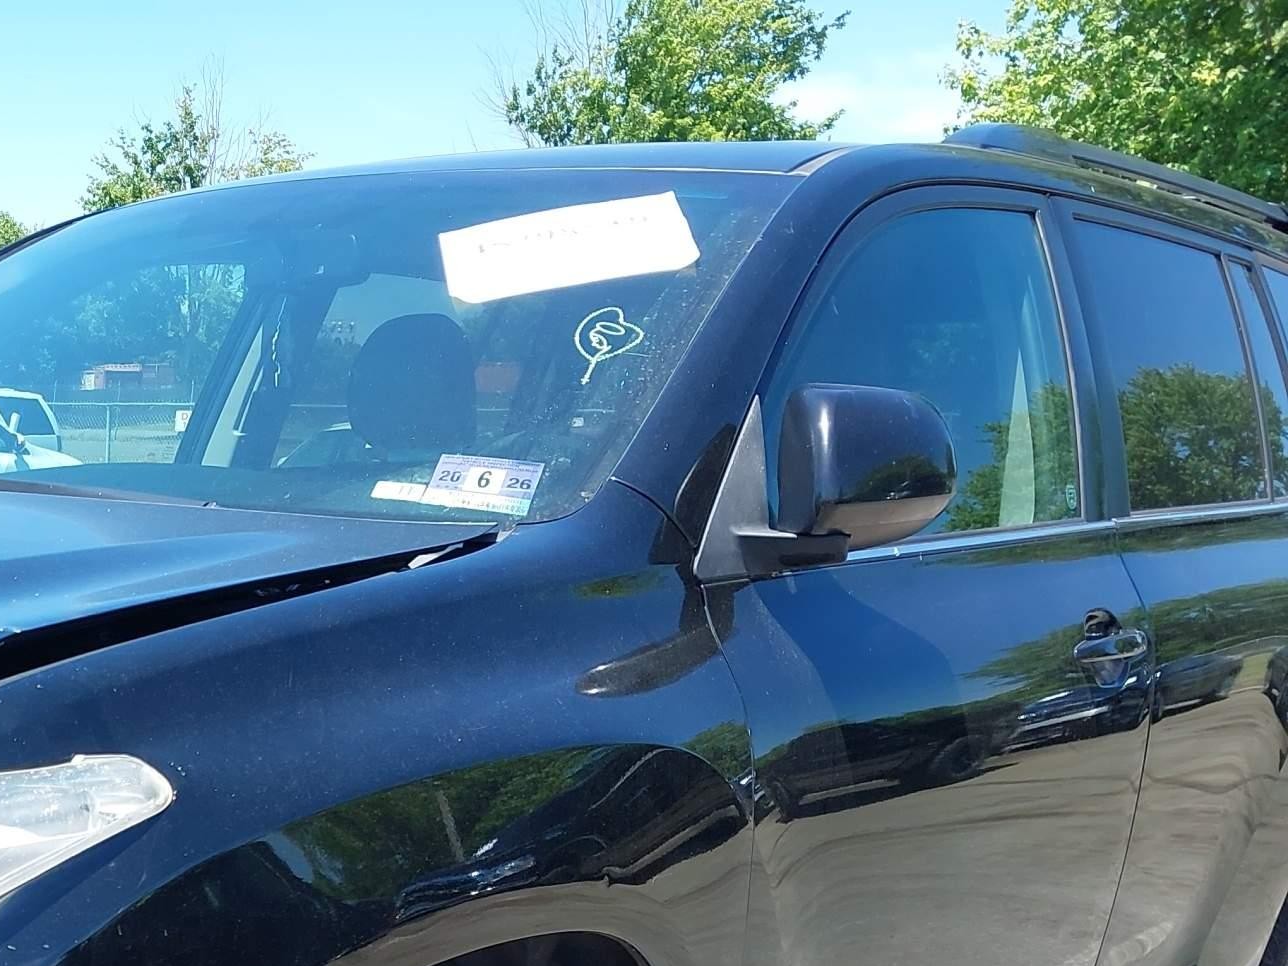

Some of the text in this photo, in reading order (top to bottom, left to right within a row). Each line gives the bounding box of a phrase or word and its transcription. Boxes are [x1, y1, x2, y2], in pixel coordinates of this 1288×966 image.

[438, 470, 533, 490] 20 6 26
